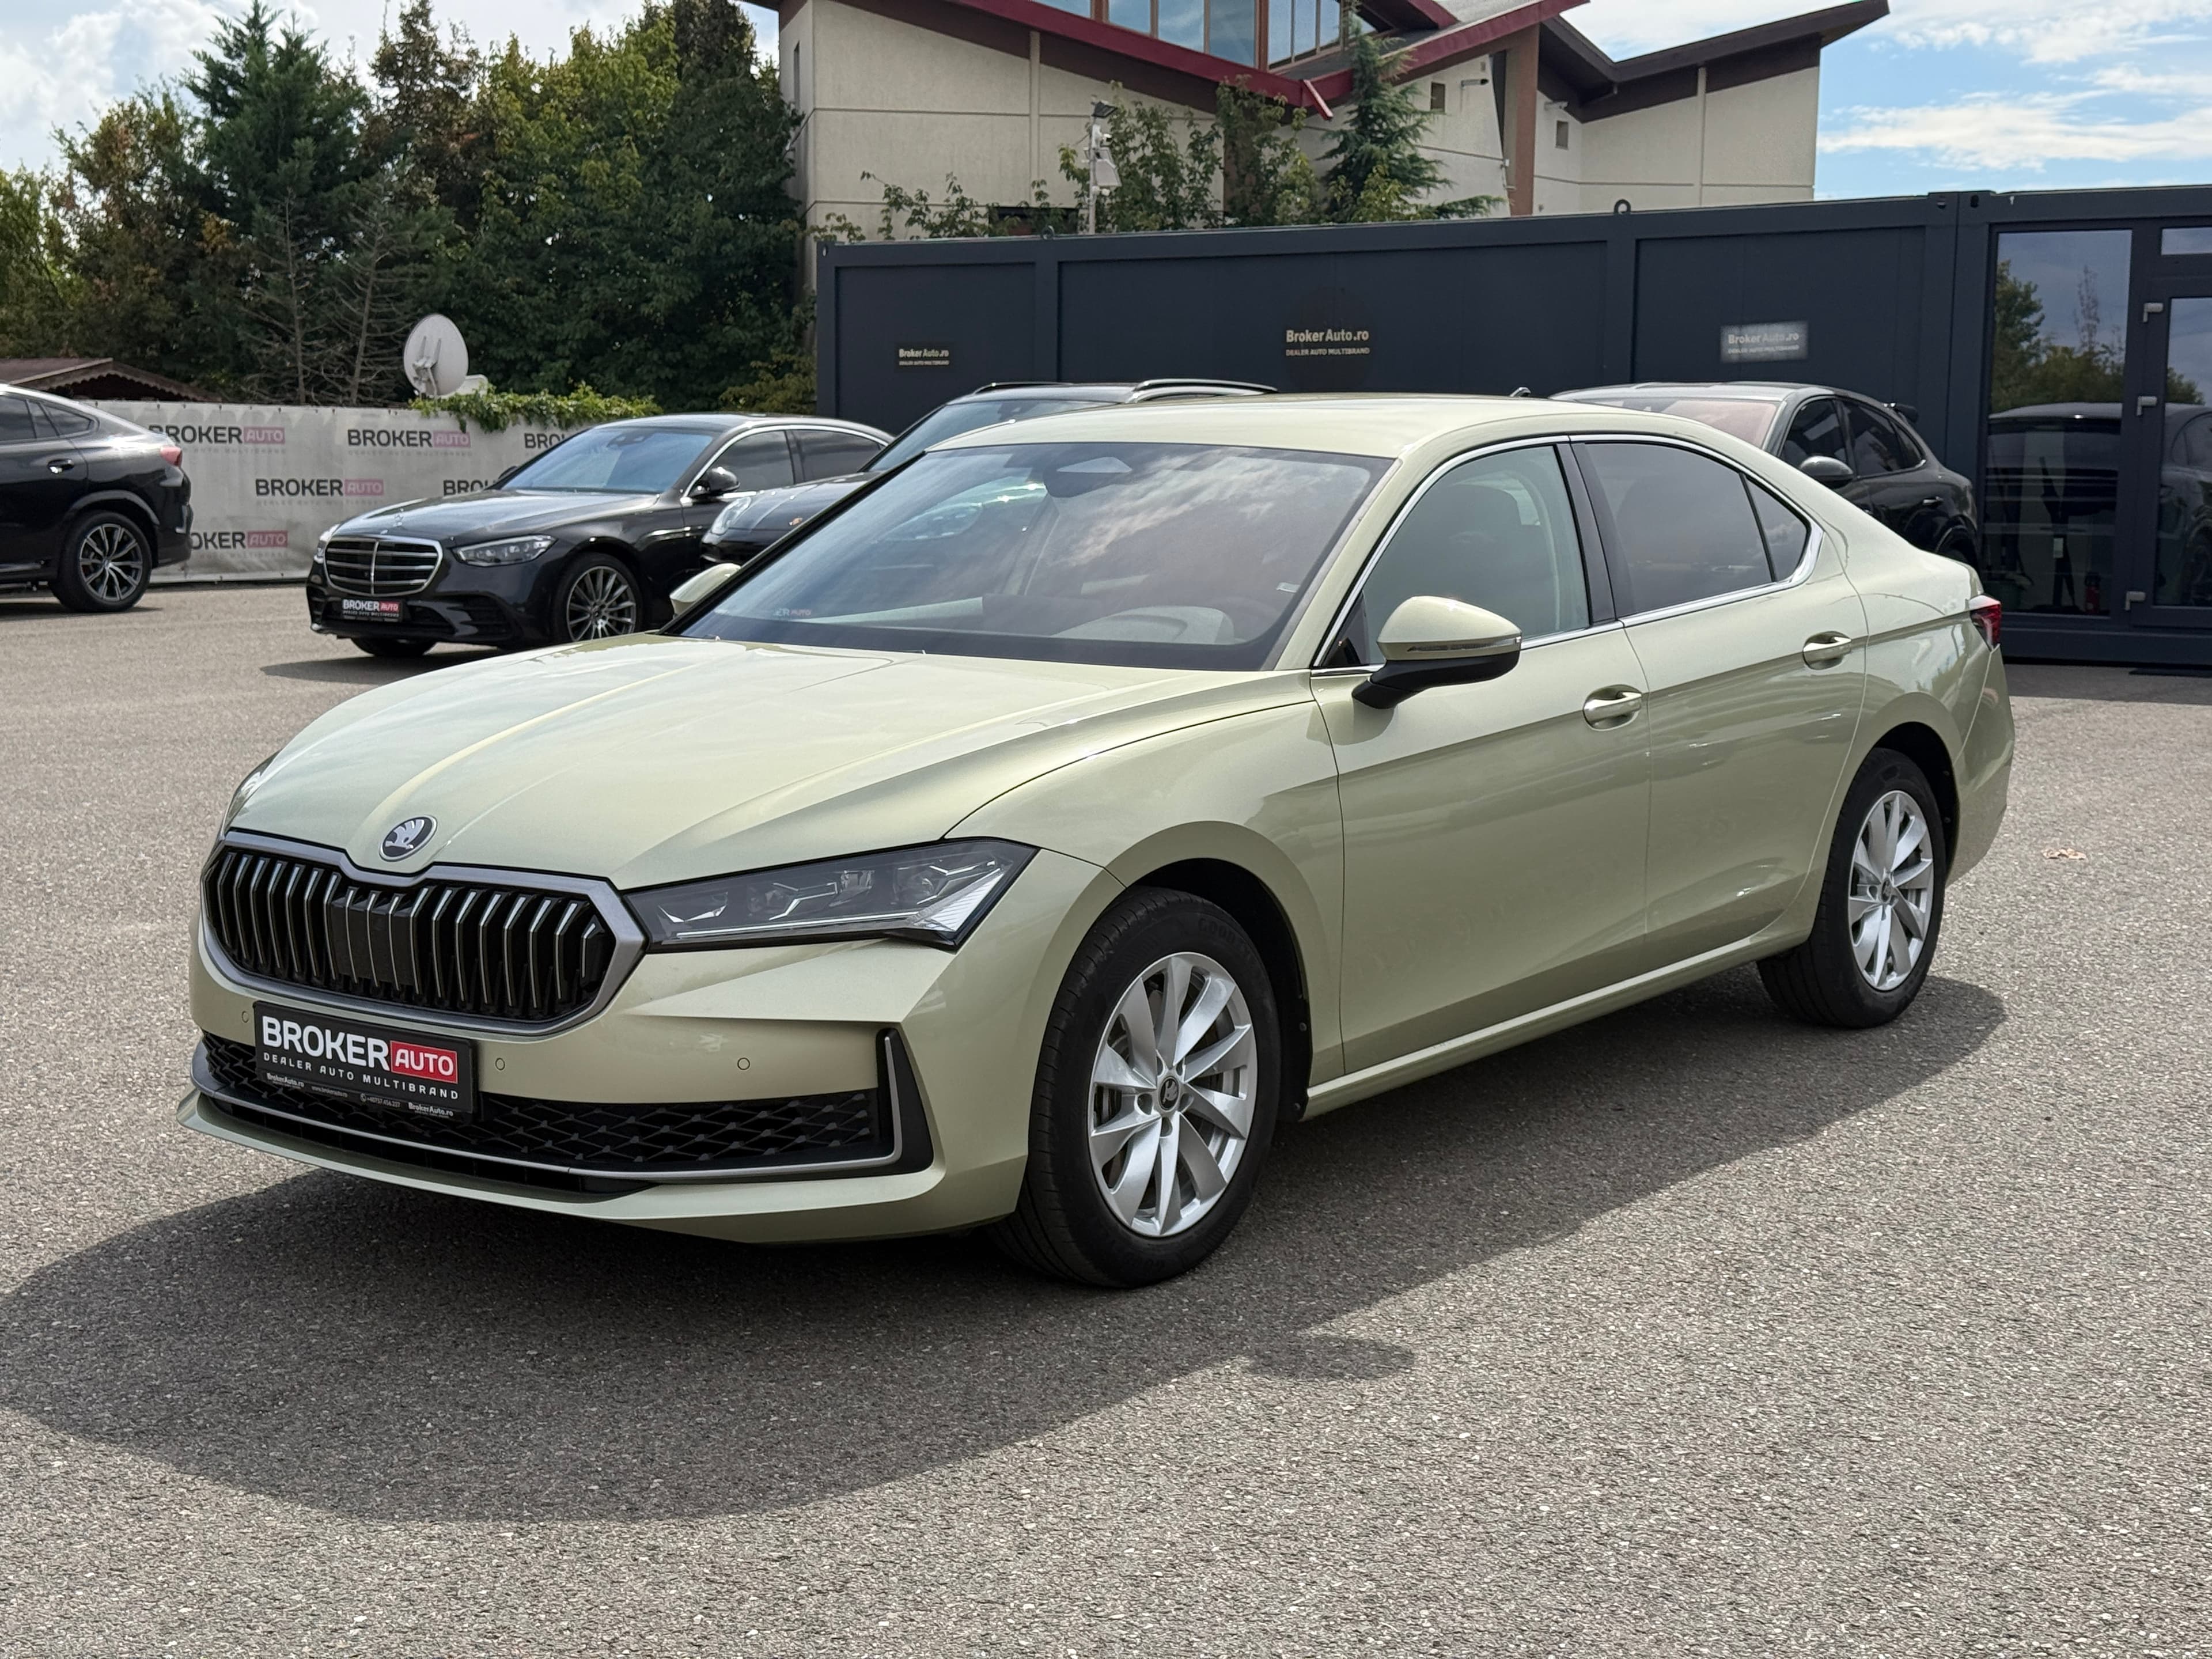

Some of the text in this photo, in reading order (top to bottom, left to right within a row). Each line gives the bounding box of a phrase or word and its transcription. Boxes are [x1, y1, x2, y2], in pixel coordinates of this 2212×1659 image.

[246, 430, 283, 442] AUTO
[347, 429, 469, 448] BROKER AUTO
[524, 433, 565, 449] BRO
[255, 479, 382, 497] BROKER AUTO
[443, 480, 490, 496] BRO
[191, 531, 287, 550] OKER AUTO
[343, 599, 399, 611] BROKER AUTO
[262, 1016, 454, 1076] BROKER AUTO
[263, 1052, 459, 1100] DEALER AUTO MULTIBRAND
[408, 1102, 454, 1116] BrokerAuto.ro
